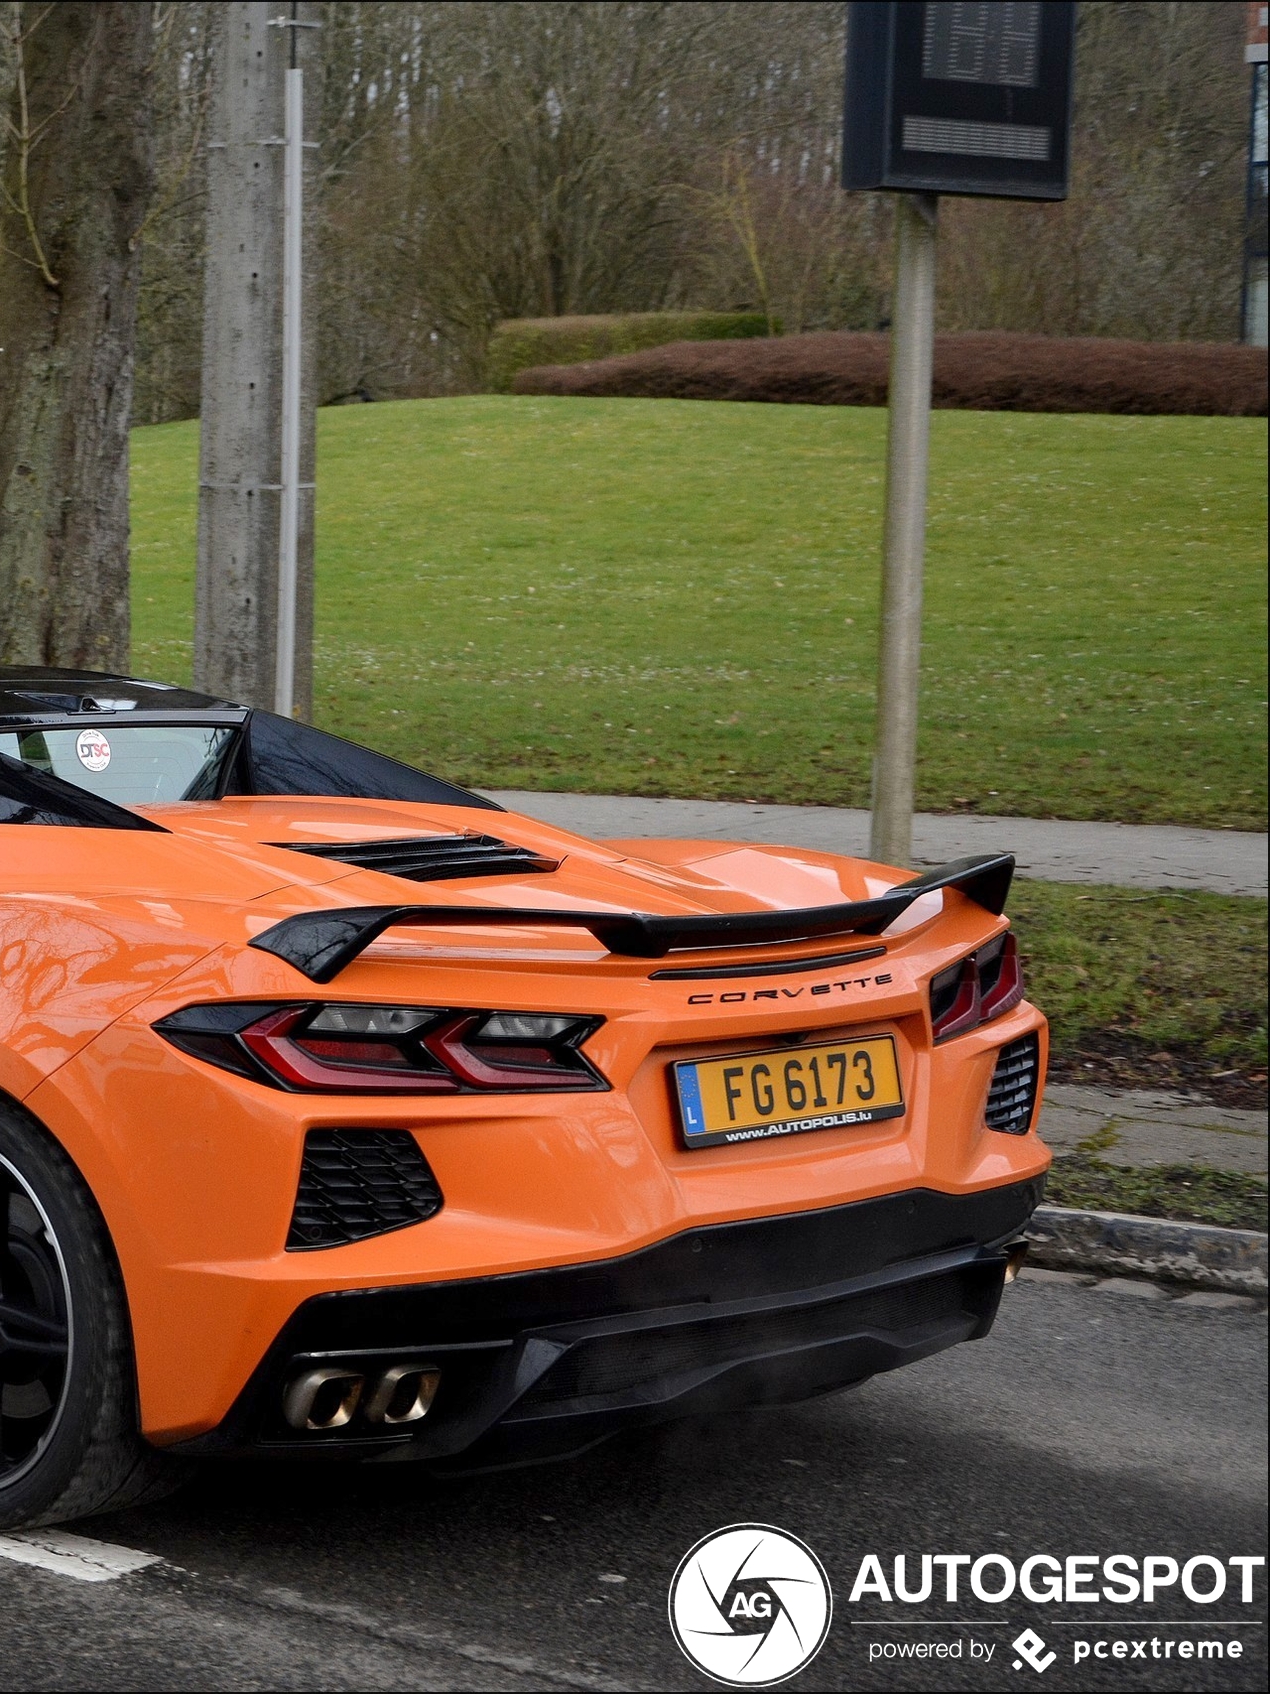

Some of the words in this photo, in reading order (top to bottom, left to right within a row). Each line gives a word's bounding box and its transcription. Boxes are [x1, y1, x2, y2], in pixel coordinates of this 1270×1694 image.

[80, 743, 110, 758] DTSC
[687, 973, 894, 1005] CORVETTE
[723, 1063, 774, 1121] FG
[783, 1050, 875, 1111] 6173
[686, 1107, 697, 1125] L
[726, 1111, 872, 1142] www.AUTOPOLIS.lu
